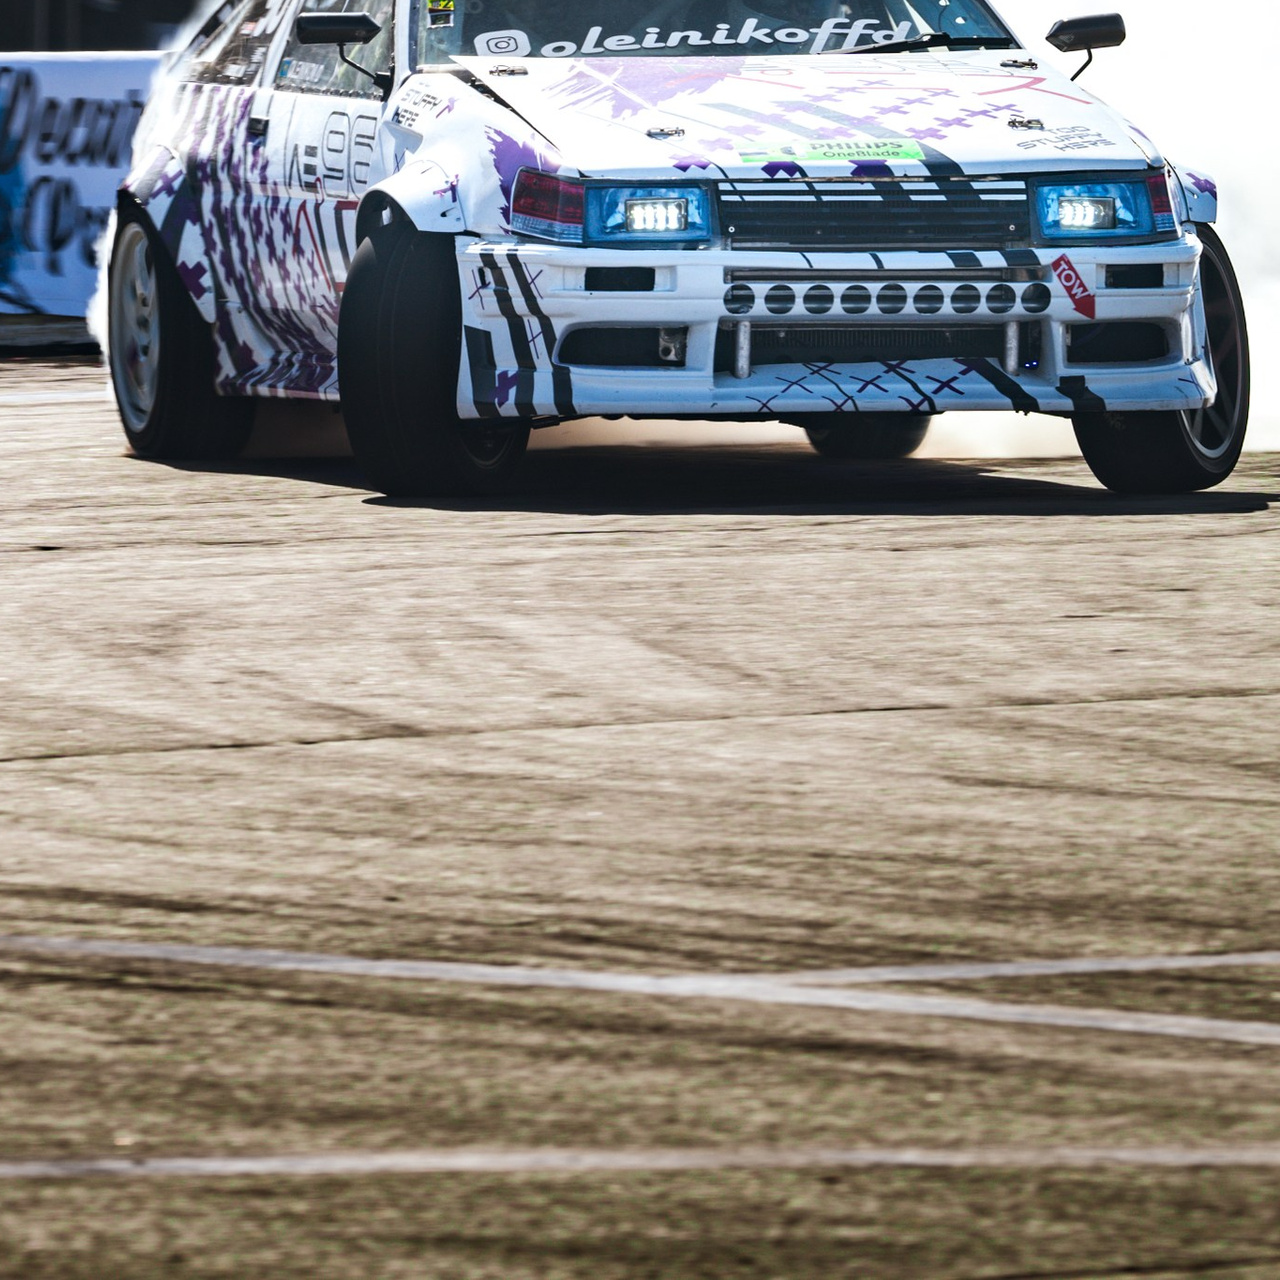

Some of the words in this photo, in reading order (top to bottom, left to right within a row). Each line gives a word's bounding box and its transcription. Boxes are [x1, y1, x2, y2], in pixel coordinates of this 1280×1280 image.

[540, 18, 913, 58] oleinikoffd
[811, 141, 904, 150] PHILIPS
[823, 150, 901, 158] OneBlade
[1055, 260, 1091, 300] TOW
